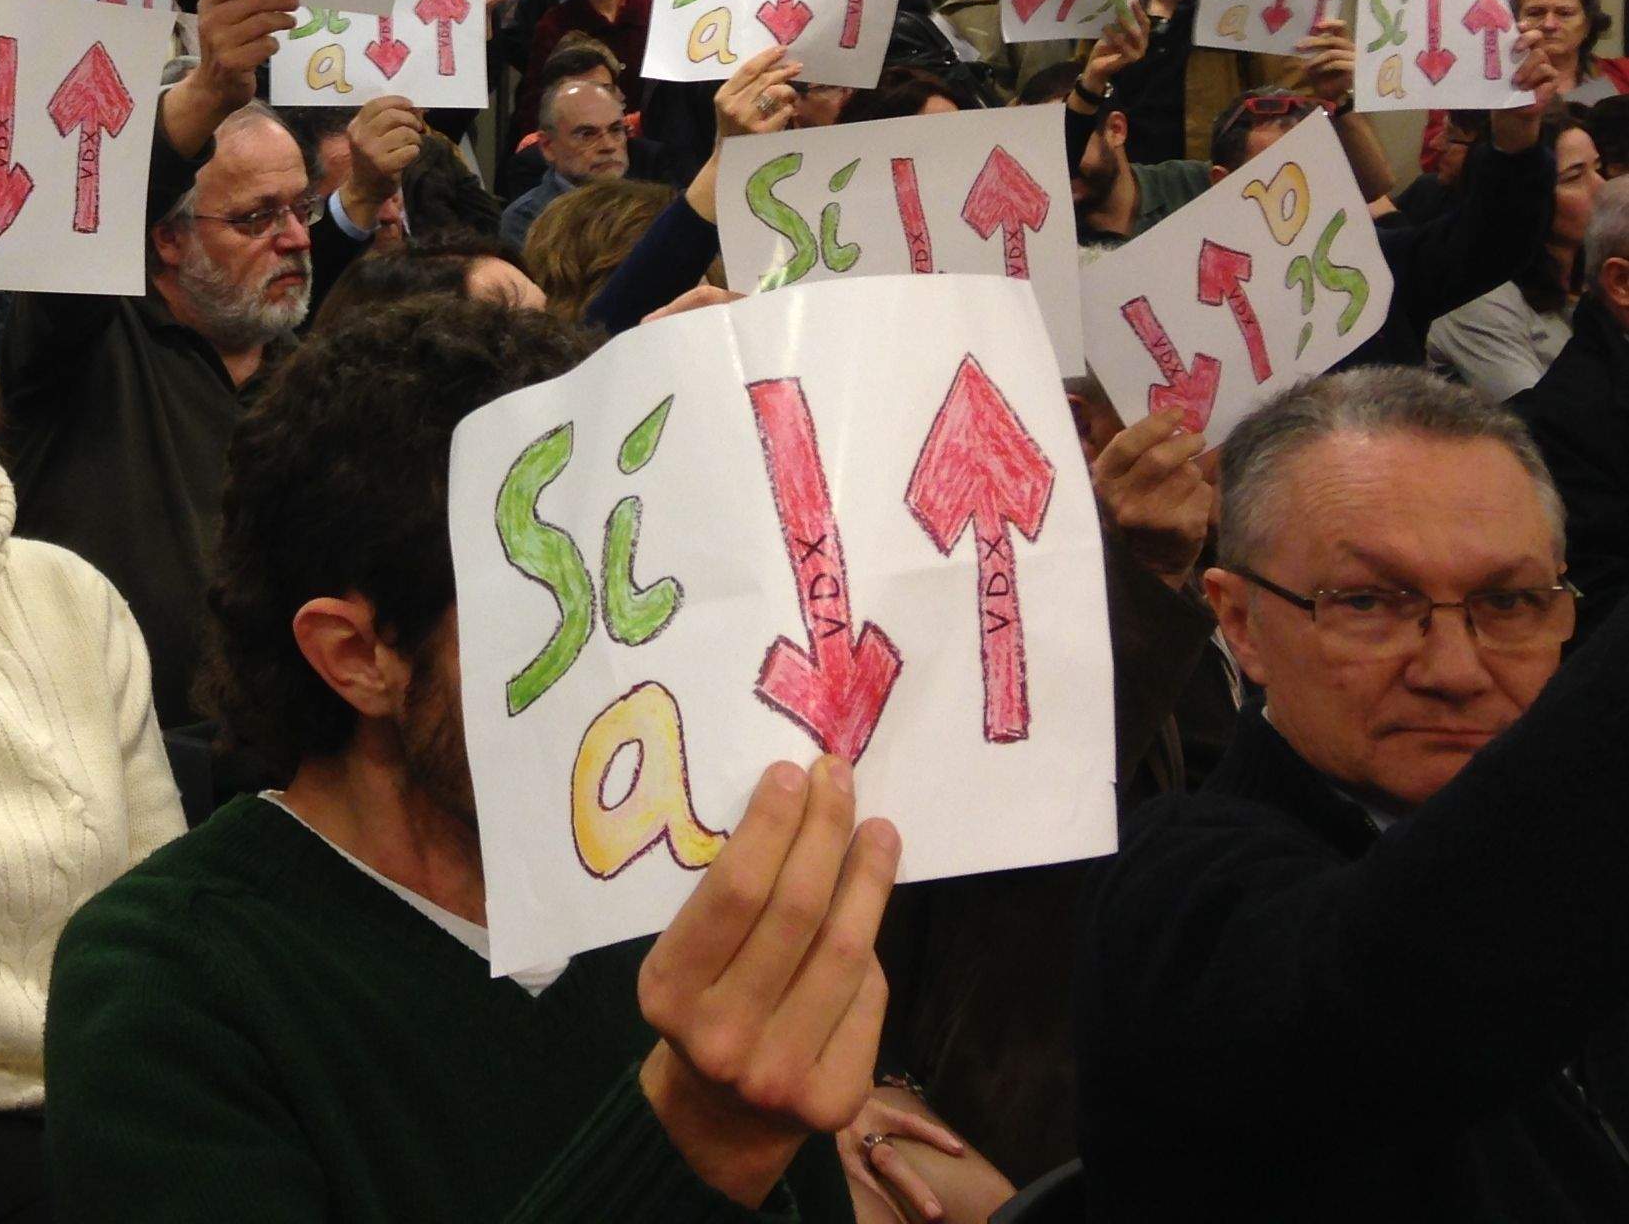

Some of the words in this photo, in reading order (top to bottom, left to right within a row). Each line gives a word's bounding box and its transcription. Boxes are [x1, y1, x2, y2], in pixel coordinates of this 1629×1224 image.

[306, 43, 353, 94] a
[687, 7, 738, 65] a
[1377, 54, 1406, 98] a
[81, 130, 99, 180] VDX
[745, 152, 862, 293] Sí
[1241, 161, 1310, 246] a
[1006, 230, 1023, 276] VDX
[1286, 208, 1369, 361] Sí
[1228, 289, 1254, 327] VDX
[1153, 336, 1184, 380] VDX
[494, 393, 685, 718] Sí
[794, 532, 846, 639] VDX
[984, 535, 1012, 635] VDX
[571, 680, 730, 881] a
